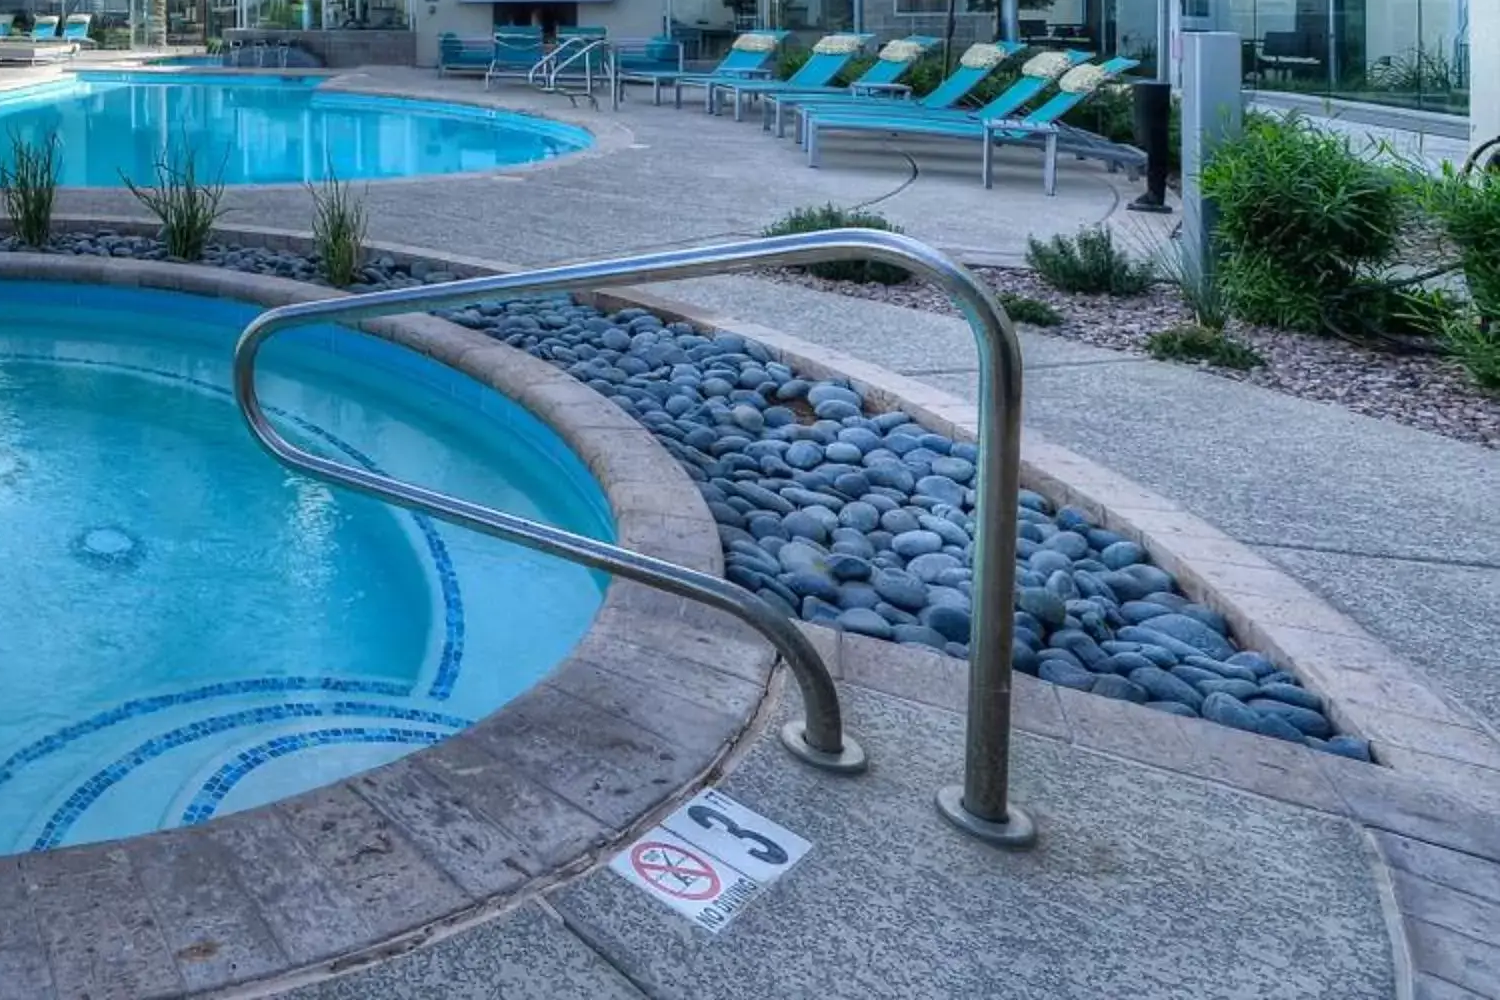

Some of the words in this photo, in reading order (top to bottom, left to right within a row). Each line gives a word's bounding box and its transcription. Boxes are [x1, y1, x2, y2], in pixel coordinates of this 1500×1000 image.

[687, 805, 789, 865] 3
[695, 907, 725, 929] NO
[714, 877, 757, 913] DIVING
